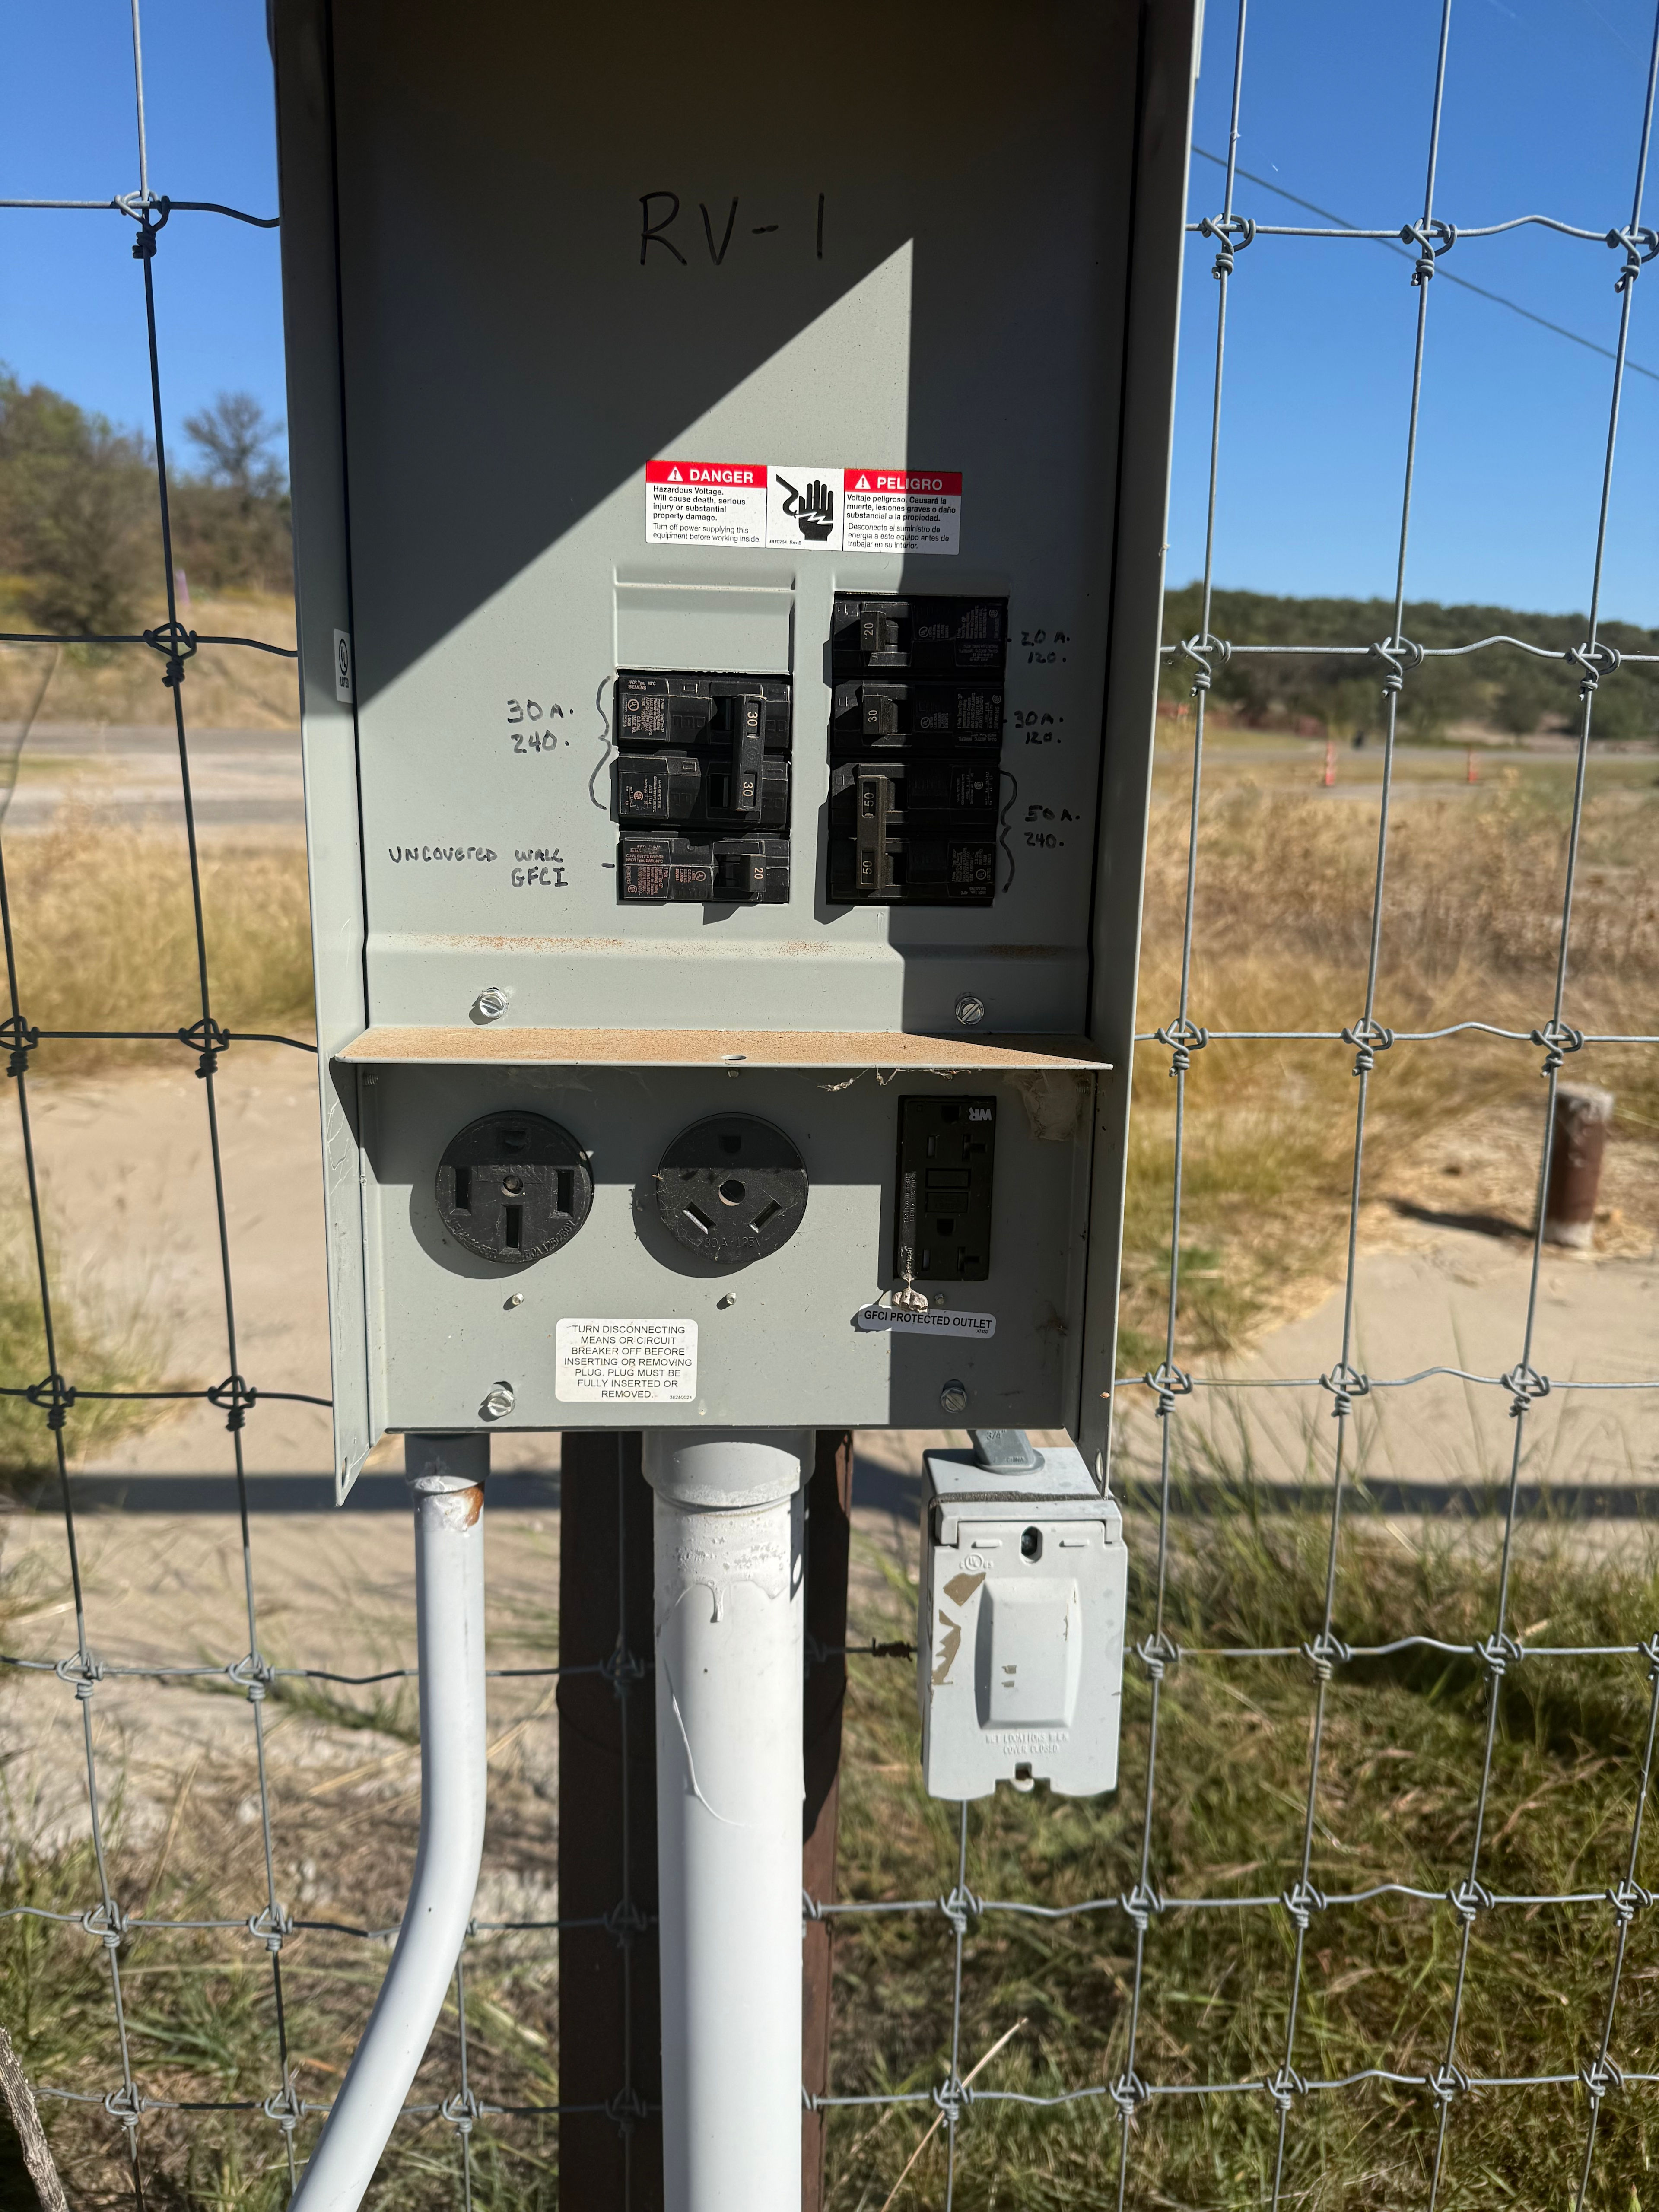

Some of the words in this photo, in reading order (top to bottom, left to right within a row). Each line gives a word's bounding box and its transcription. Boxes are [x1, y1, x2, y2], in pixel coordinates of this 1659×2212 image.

[690, 469, 753, 483] DANGER
[877, 477, 943, 490] PELIGRO
[695, 487, 724, 496] Voltage.
[847, 494, 871, 502] Voltaje
[653, 503, 673, 511] injury
[686, 513, 717, 521] damage.
[703, 526, 734, 534] supplying
[864, 623, 874, 636] 20
[340, 677, 349, 688] LISTED
[747, 712, 758, 726] 30
[868, 710, 877, 722] 30
[743, 782, 753, 796] 30
[864, 792, 874, 807] 50
[754, 867, 764, 880] 20
[862, 860, 872, 874] 50
[511, 866, 568, 887] GFCI
[968, 1109, 992, 1122] WR
[864, 1310, 887, 1320] GFCI
[890, 1312, 950, 1325] PROTECTED
[953, 1317, 992, 1328] OUTLET
[1030, 1745, 1059, 1753] CLOSED
